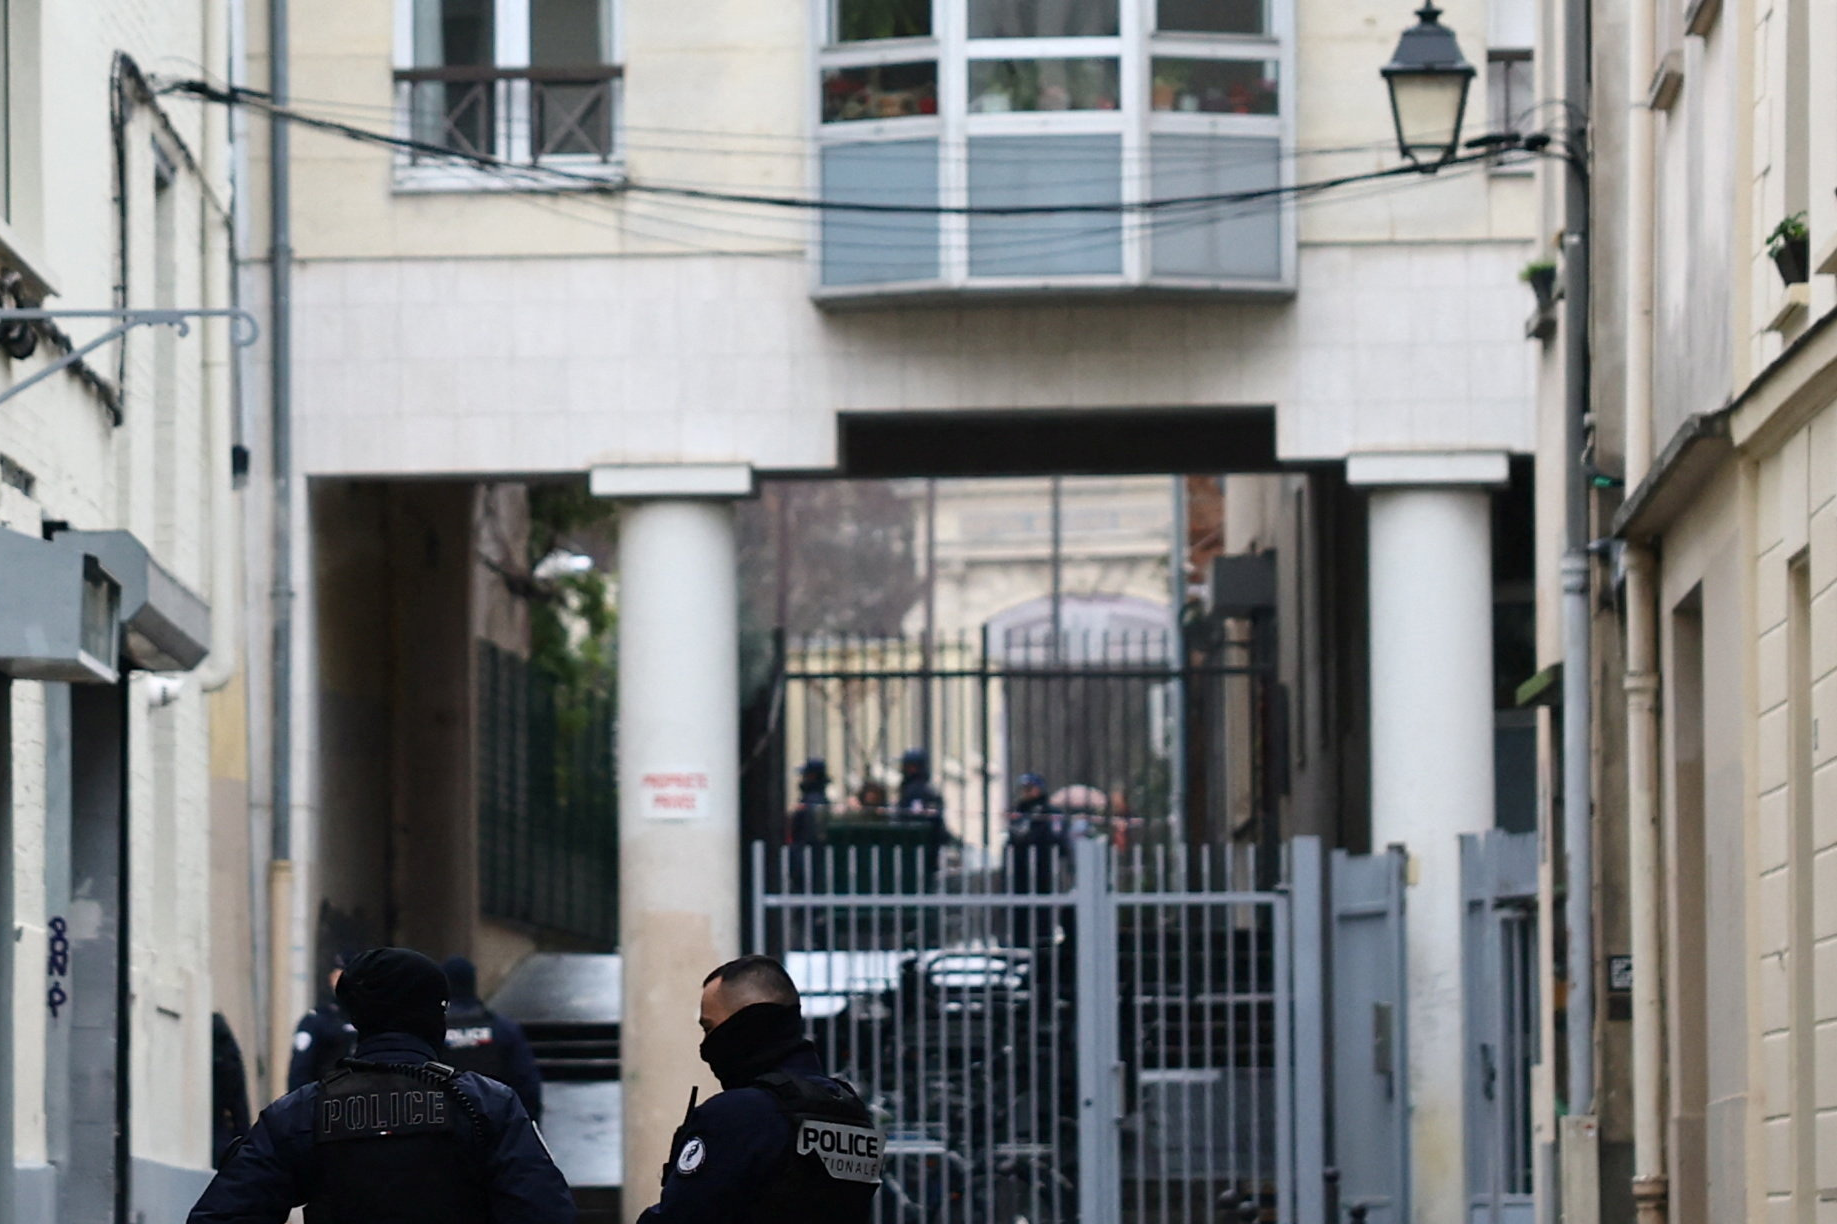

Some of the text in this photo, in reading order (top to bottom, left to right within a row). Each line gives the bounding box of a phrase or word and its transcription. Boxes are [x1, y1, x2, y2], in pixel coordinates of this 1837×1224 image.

[445, 1027, 493, 1041] OLICE
[323, 1090, 445, 1134] POLICE
[803, 1127, 879, 1159] POLICE
[823, 1156, 878, 1177] TIONALE
